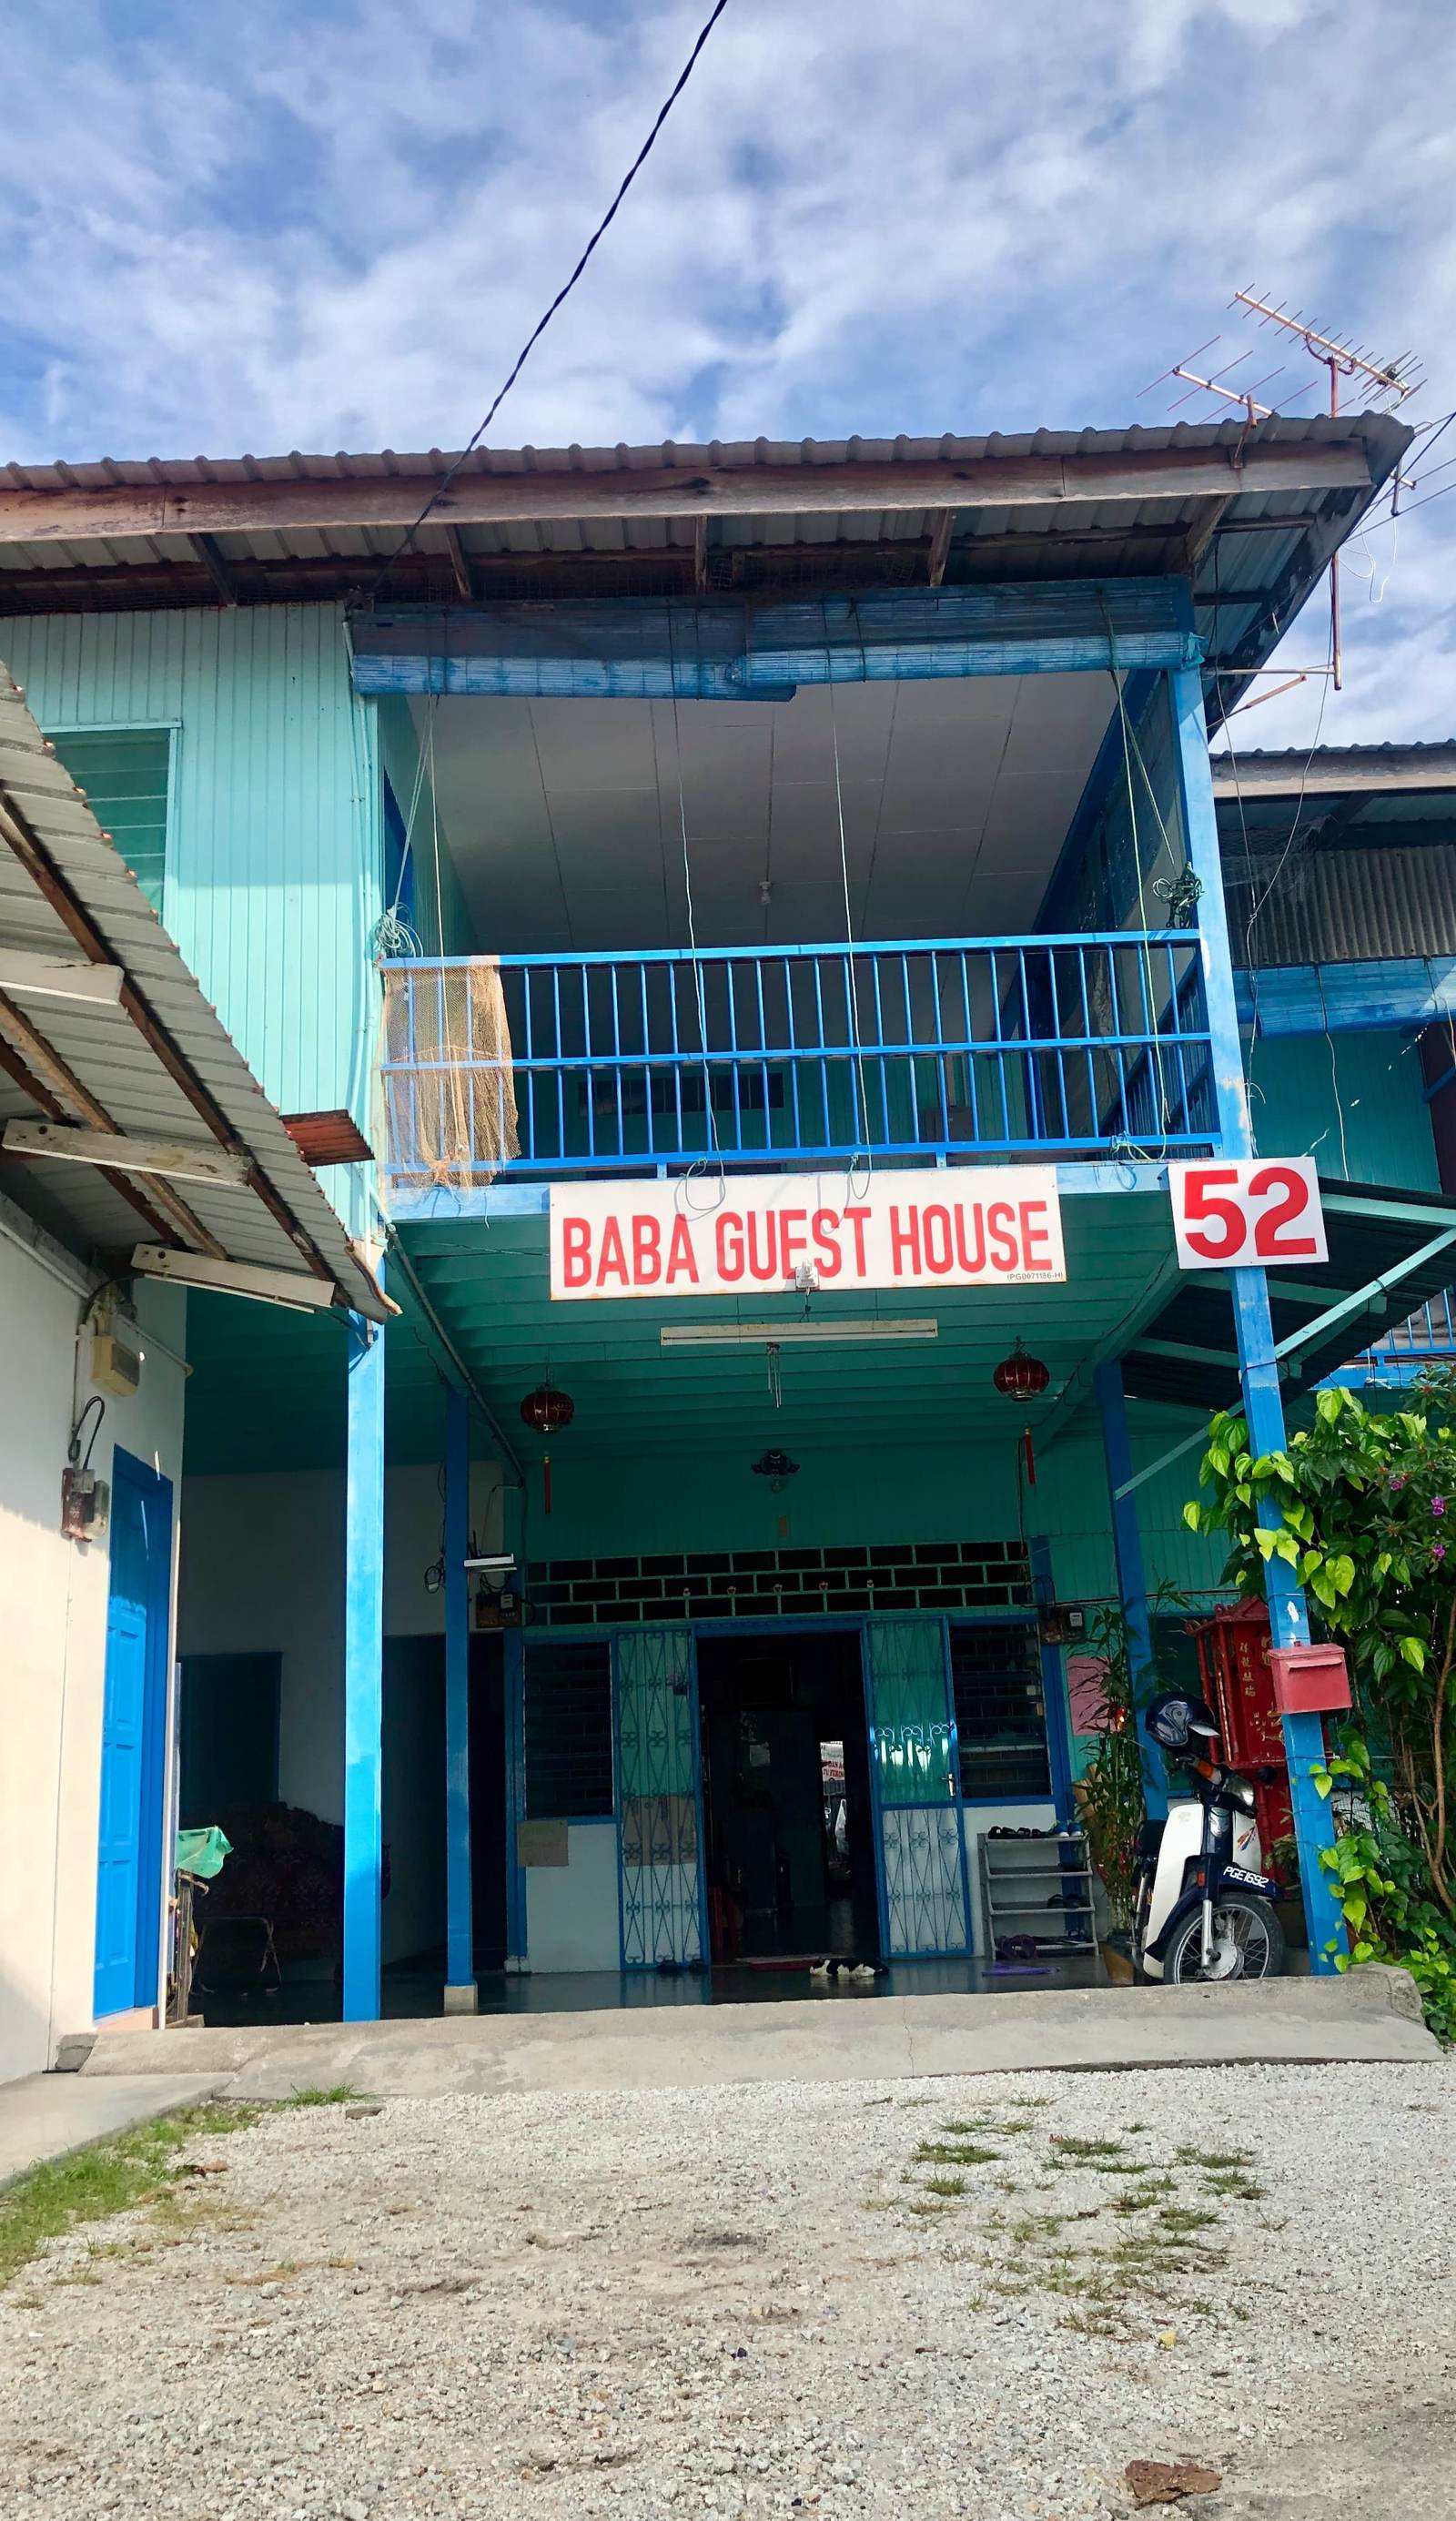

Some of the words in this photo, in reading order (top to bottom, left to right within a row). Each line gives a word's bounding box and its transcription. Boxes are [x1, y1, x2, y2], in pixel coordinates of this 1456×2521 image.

[563, 1214, 700, 1287] BABA
[715, 1208, 872, 1281] GUEST
[889, 1200, 1053, 1276] HOUSE
[1184, 1167, 1317, 1259] 52
[1222, 1866, 1269, 1888] PGE1692
